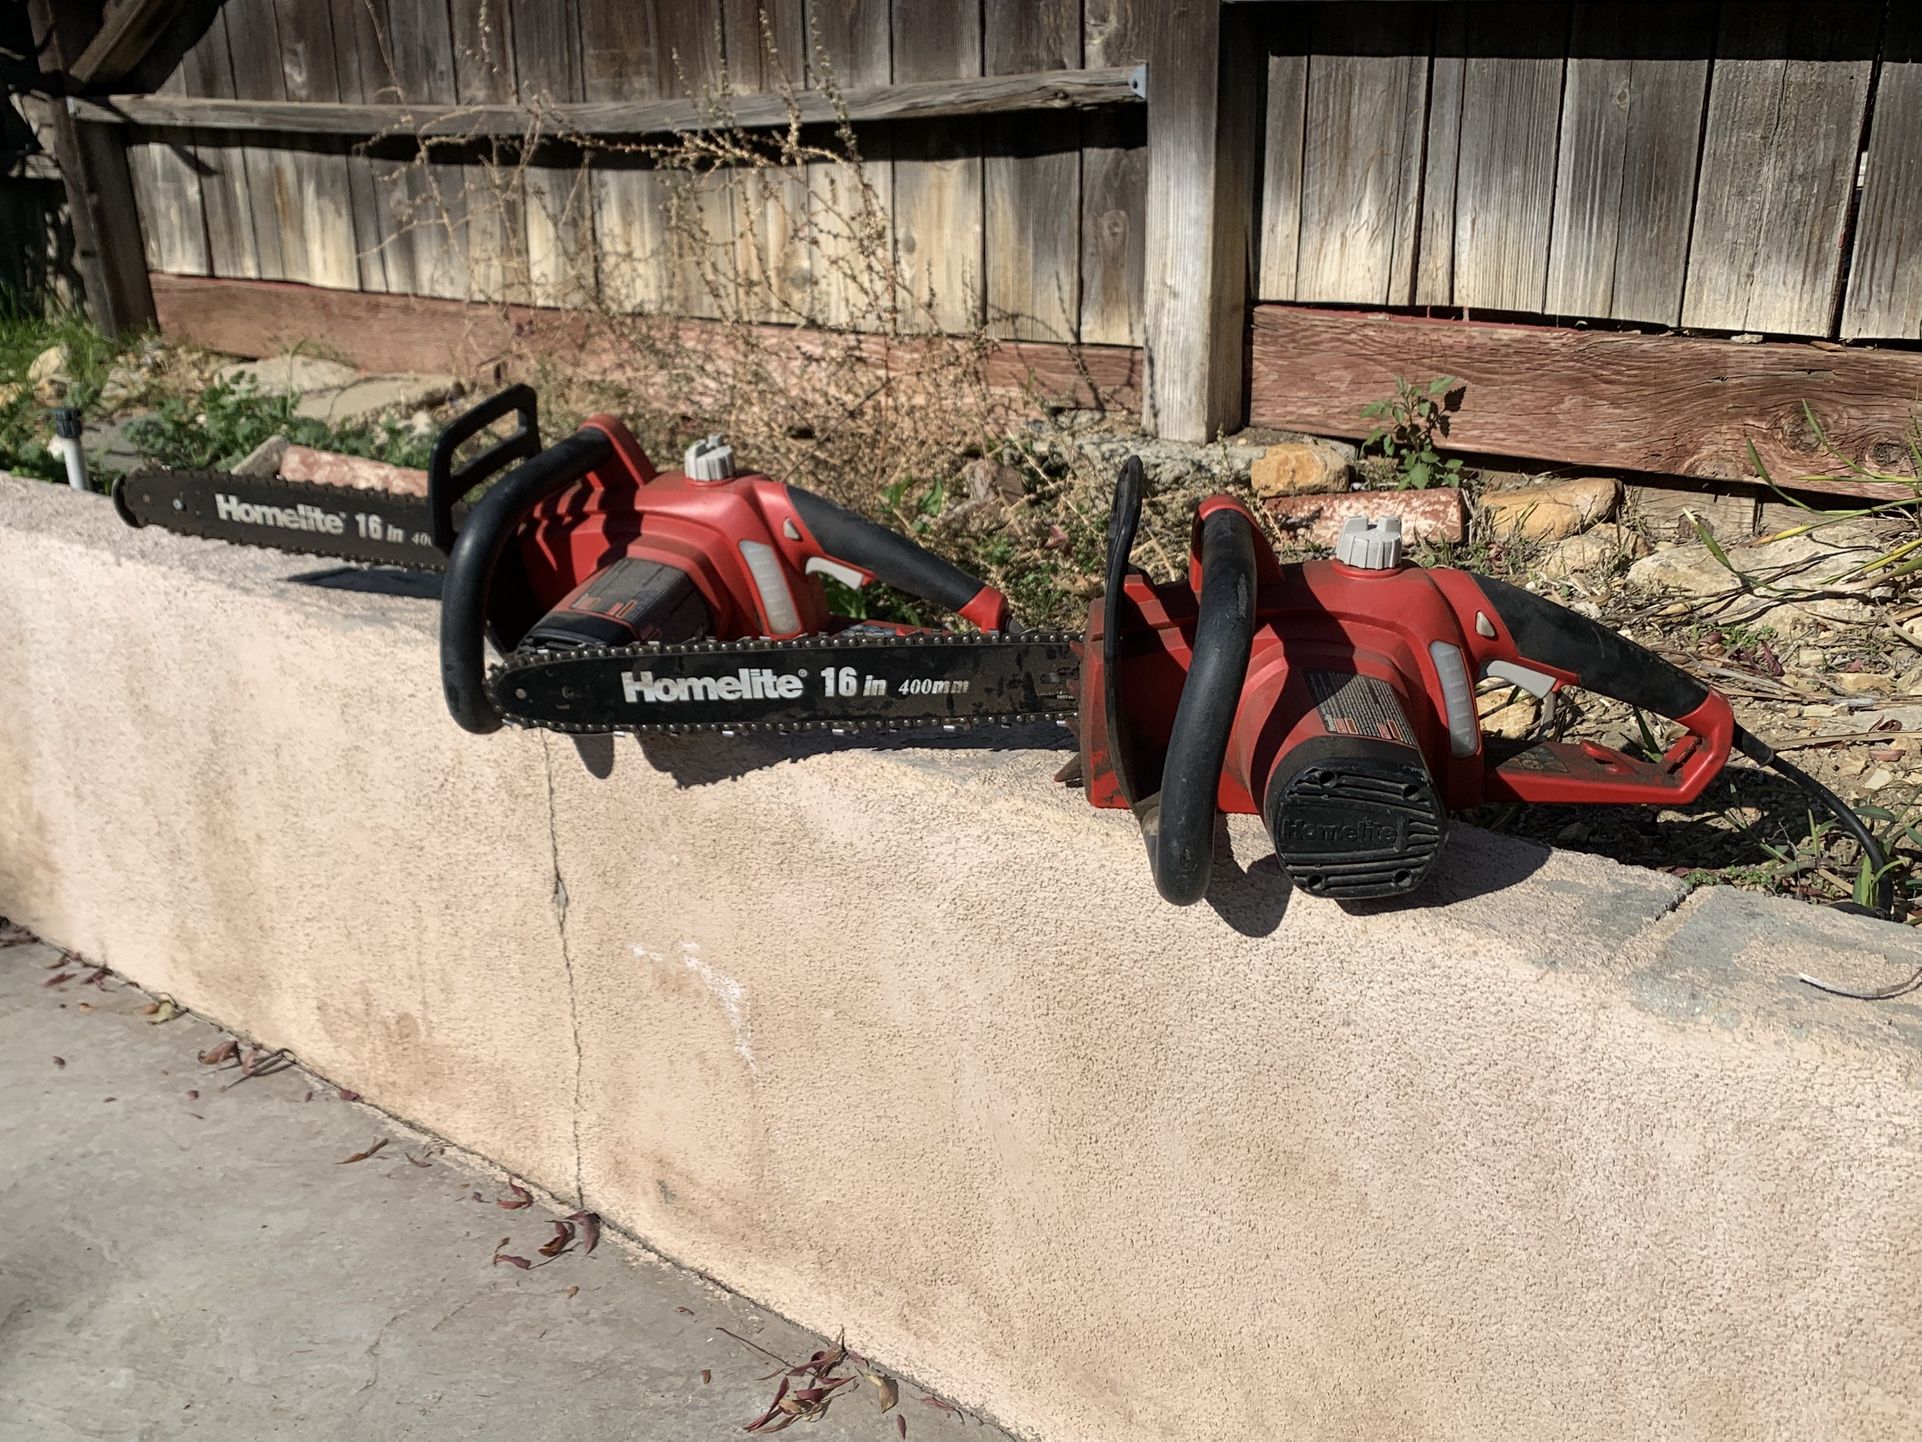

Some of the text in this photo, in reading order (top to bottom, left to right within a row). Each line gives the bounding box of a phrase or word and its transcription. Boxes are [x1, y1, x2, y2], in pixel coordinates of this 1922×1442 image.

[355, 513, 382, 540] 16
[386, 524, 404, 543] in
[820, 666, 858, 697] 16
[862, 675, 887, 696] in
[898, 678, 970, 695] 400mm
[1281, 816, 1398, 843] Homelite
